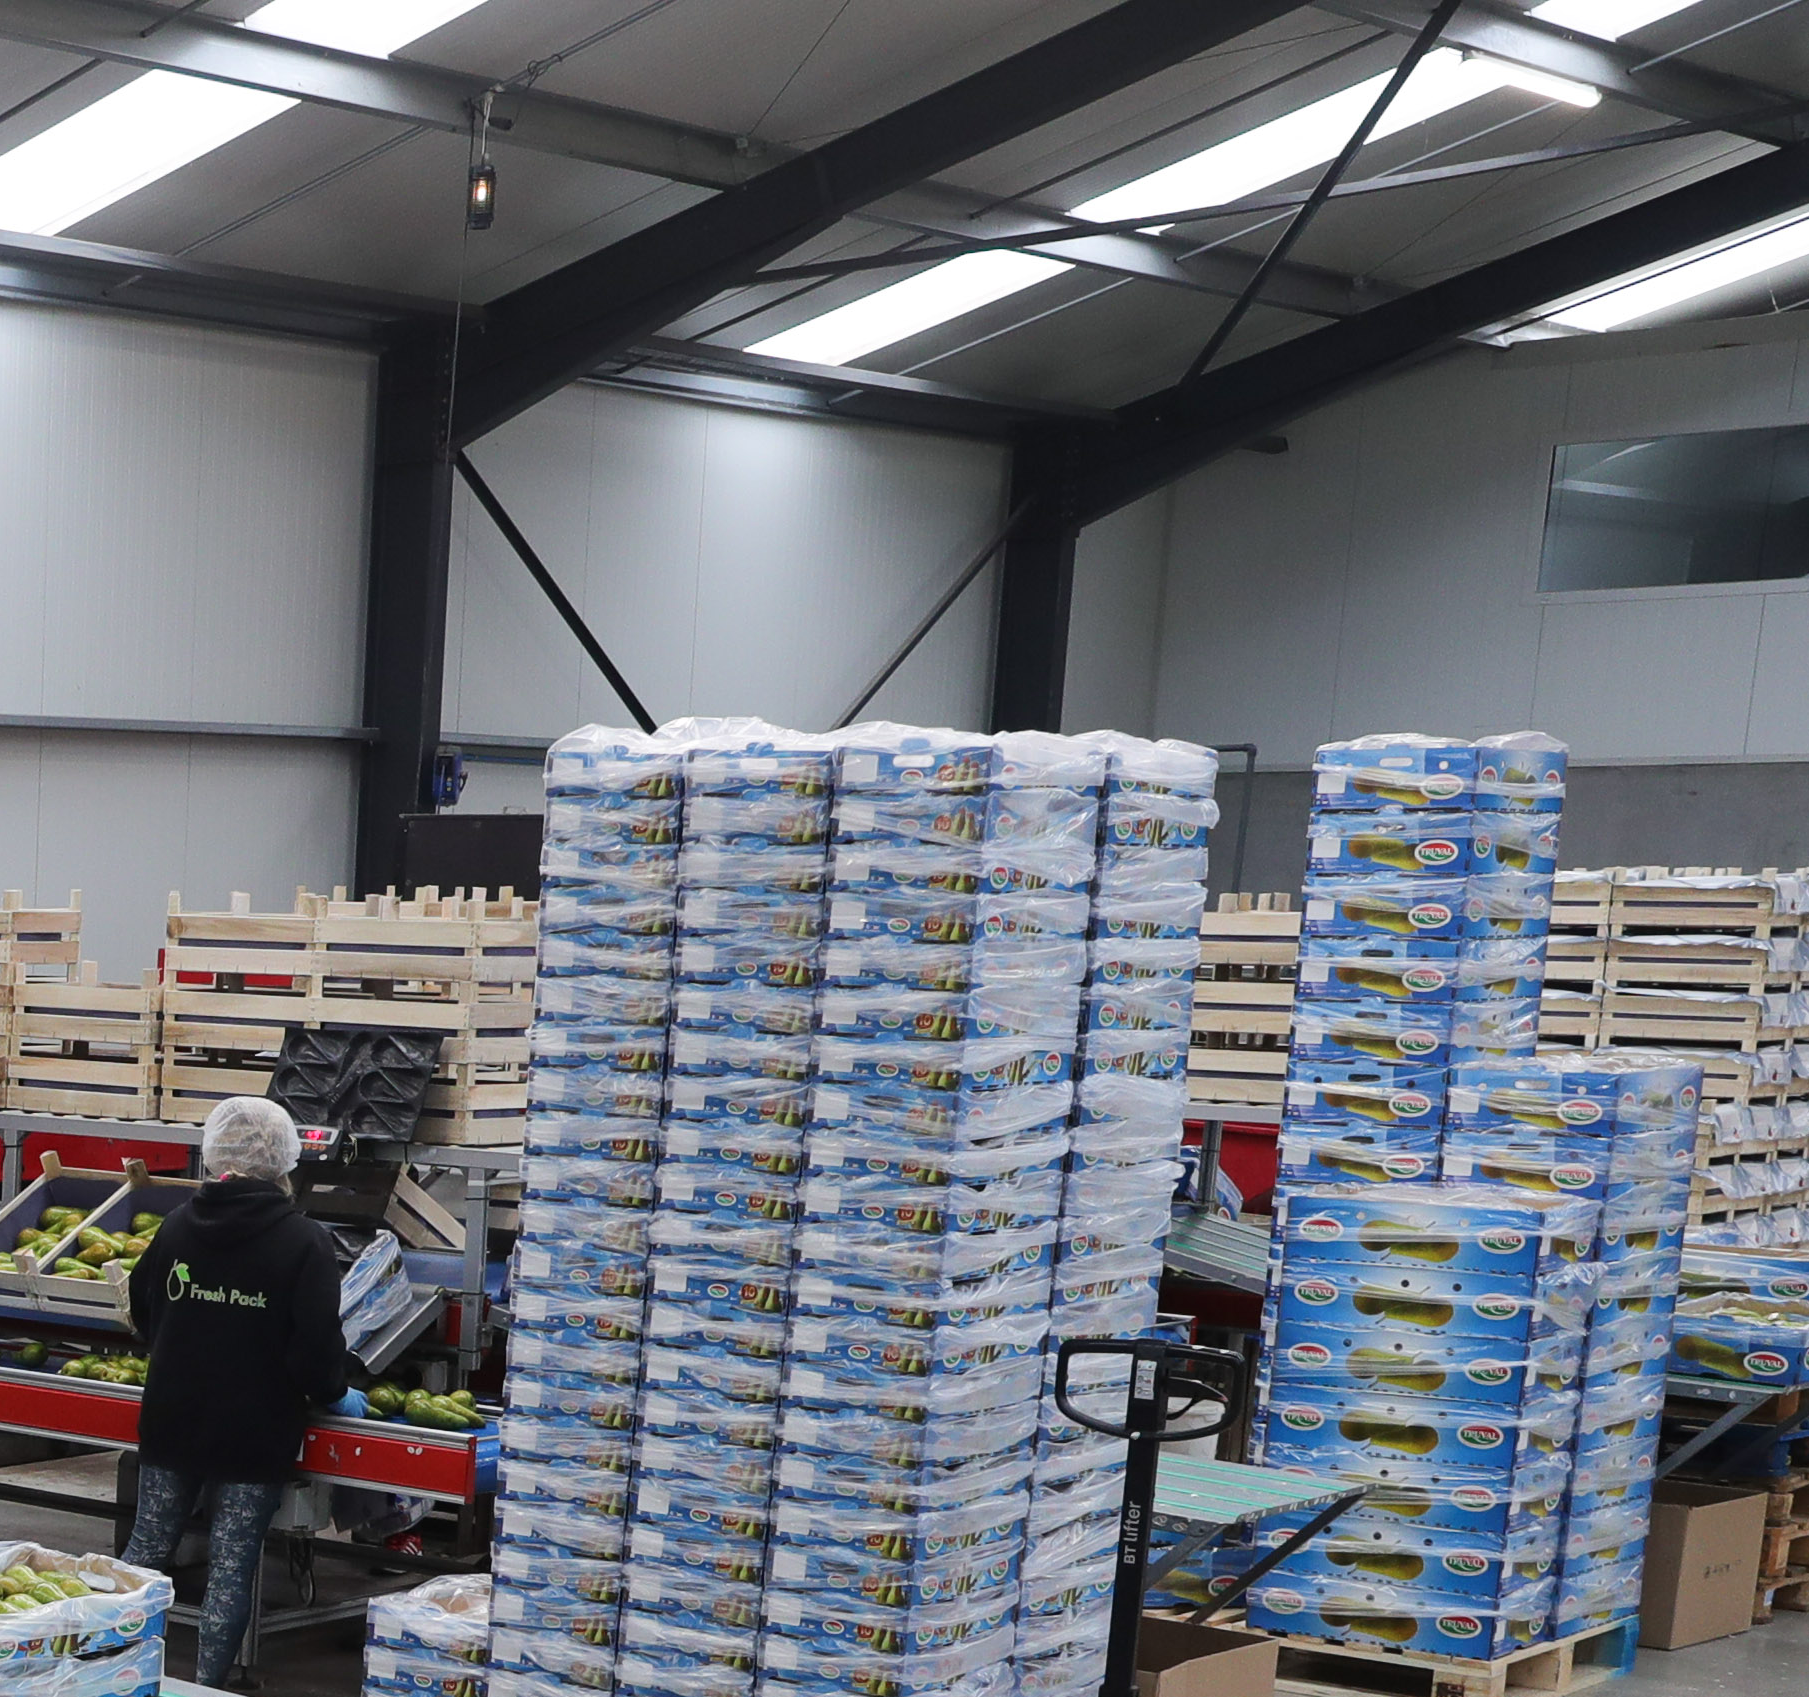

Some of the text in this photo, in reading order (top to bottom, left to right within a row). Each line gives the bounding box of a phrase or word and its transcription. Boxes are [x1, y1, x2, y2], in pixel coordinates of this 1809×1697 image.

[1420, 847, 1452, 857] TRUVAL
[1413, 911, 1447, 920] TRUVAL
[190, 1283, 268, 1309] Fresh Pack
[1300, 1286, 1334, 1298] TRUVAL
[1750, 1357, 1783, 1369] TRUVAL
[1461, 1429, 1499, 1441] TRUVAL
[1123, 1500, 1142, 1565] BT lifter
[1441, 1618, 1478, 1631] TRUVAL
